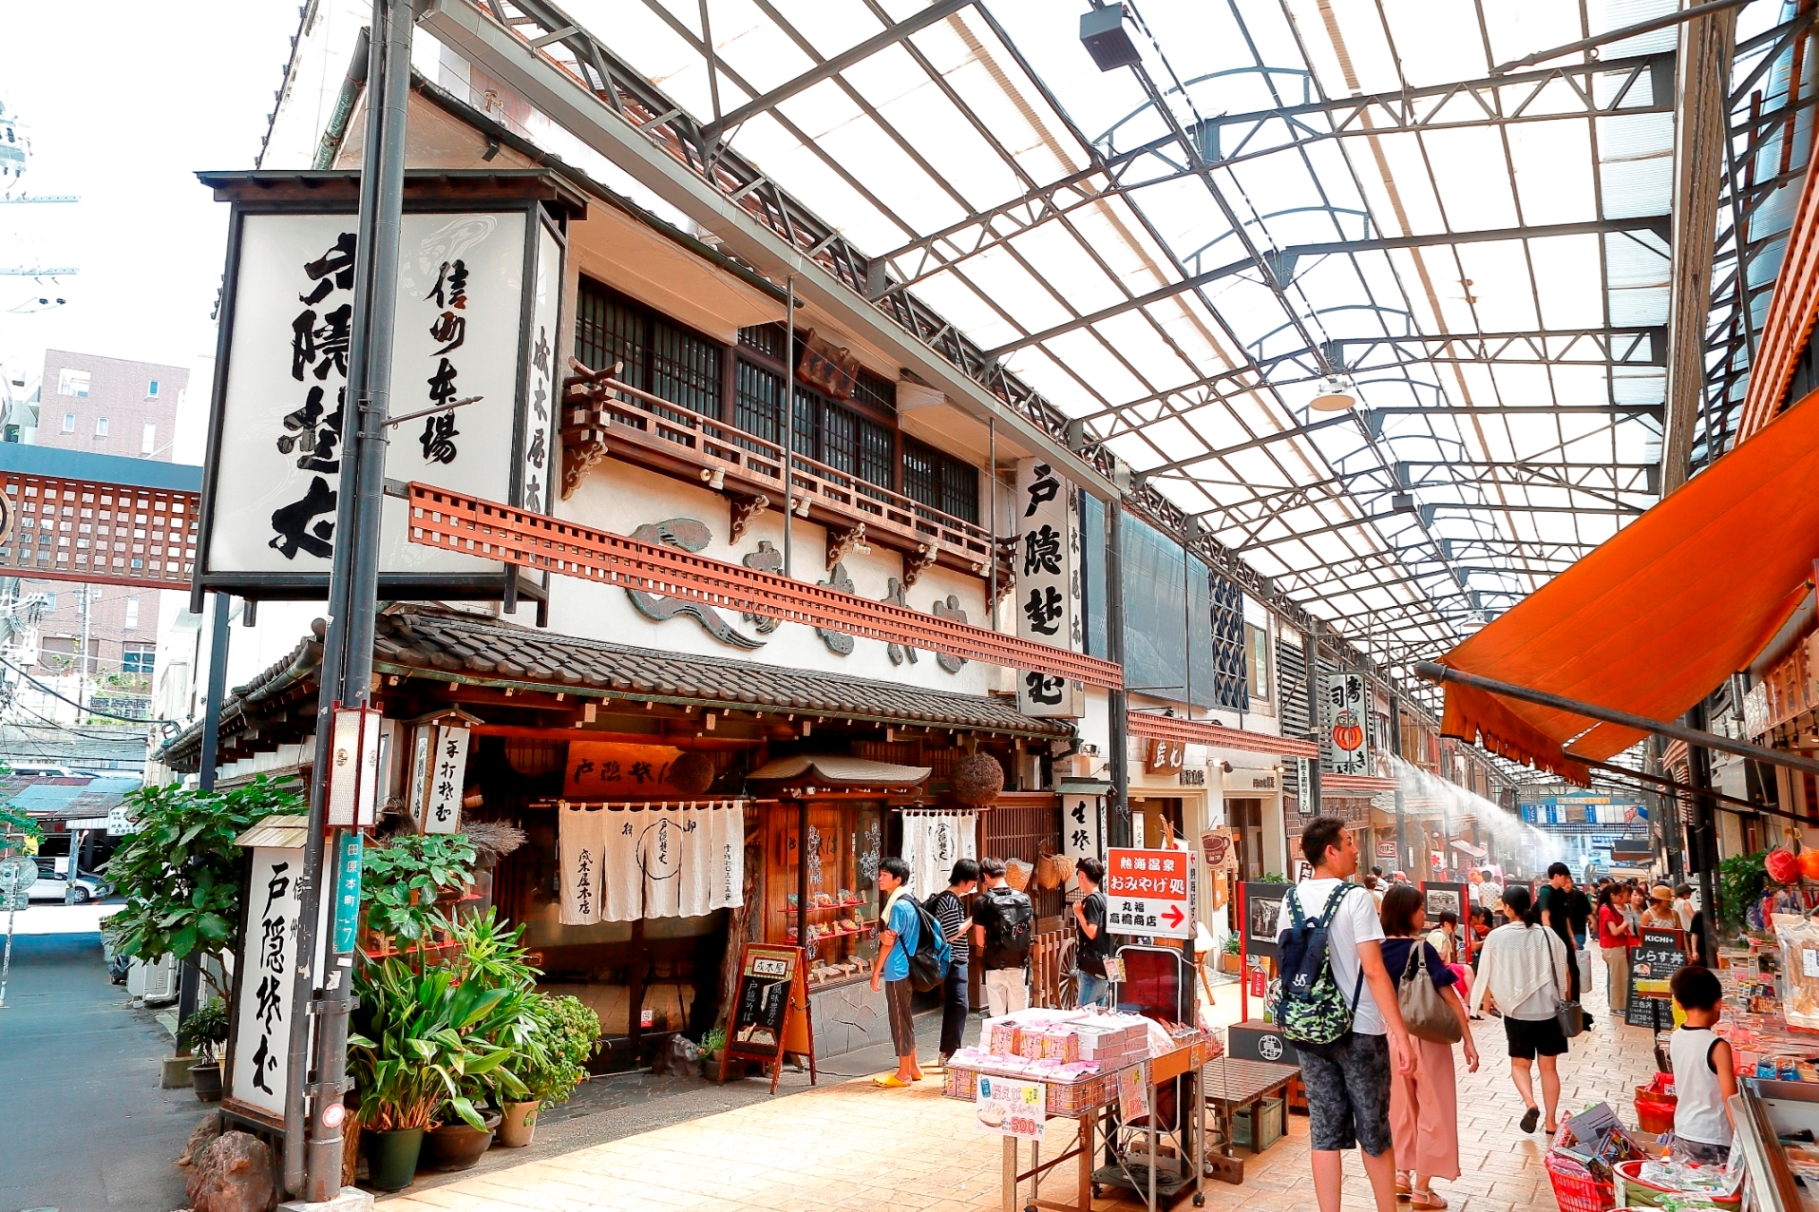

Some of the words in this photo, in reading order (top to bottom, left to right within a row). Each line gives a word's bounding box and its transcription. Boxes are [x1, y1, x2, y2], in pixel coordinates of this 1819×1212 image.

[1330, 675, 1362, 708] 寿司
[1120, 856, 1175, 872] 熱海温泉
[343, 843, 359, 907] 田原本町
[576, 848, 593, 915] 成木屋本店
[1110, 875, 1185, 895] おみやげ処
[1122, 900, 1145, 912] 丸福
[1109, 912, 1157, 927] 高橋商店
[1635, 949, 1684, 964] しらす丼
[756, 961, 784, 974] 成木屋
[1011, 1116, 1037, 1135] 500
